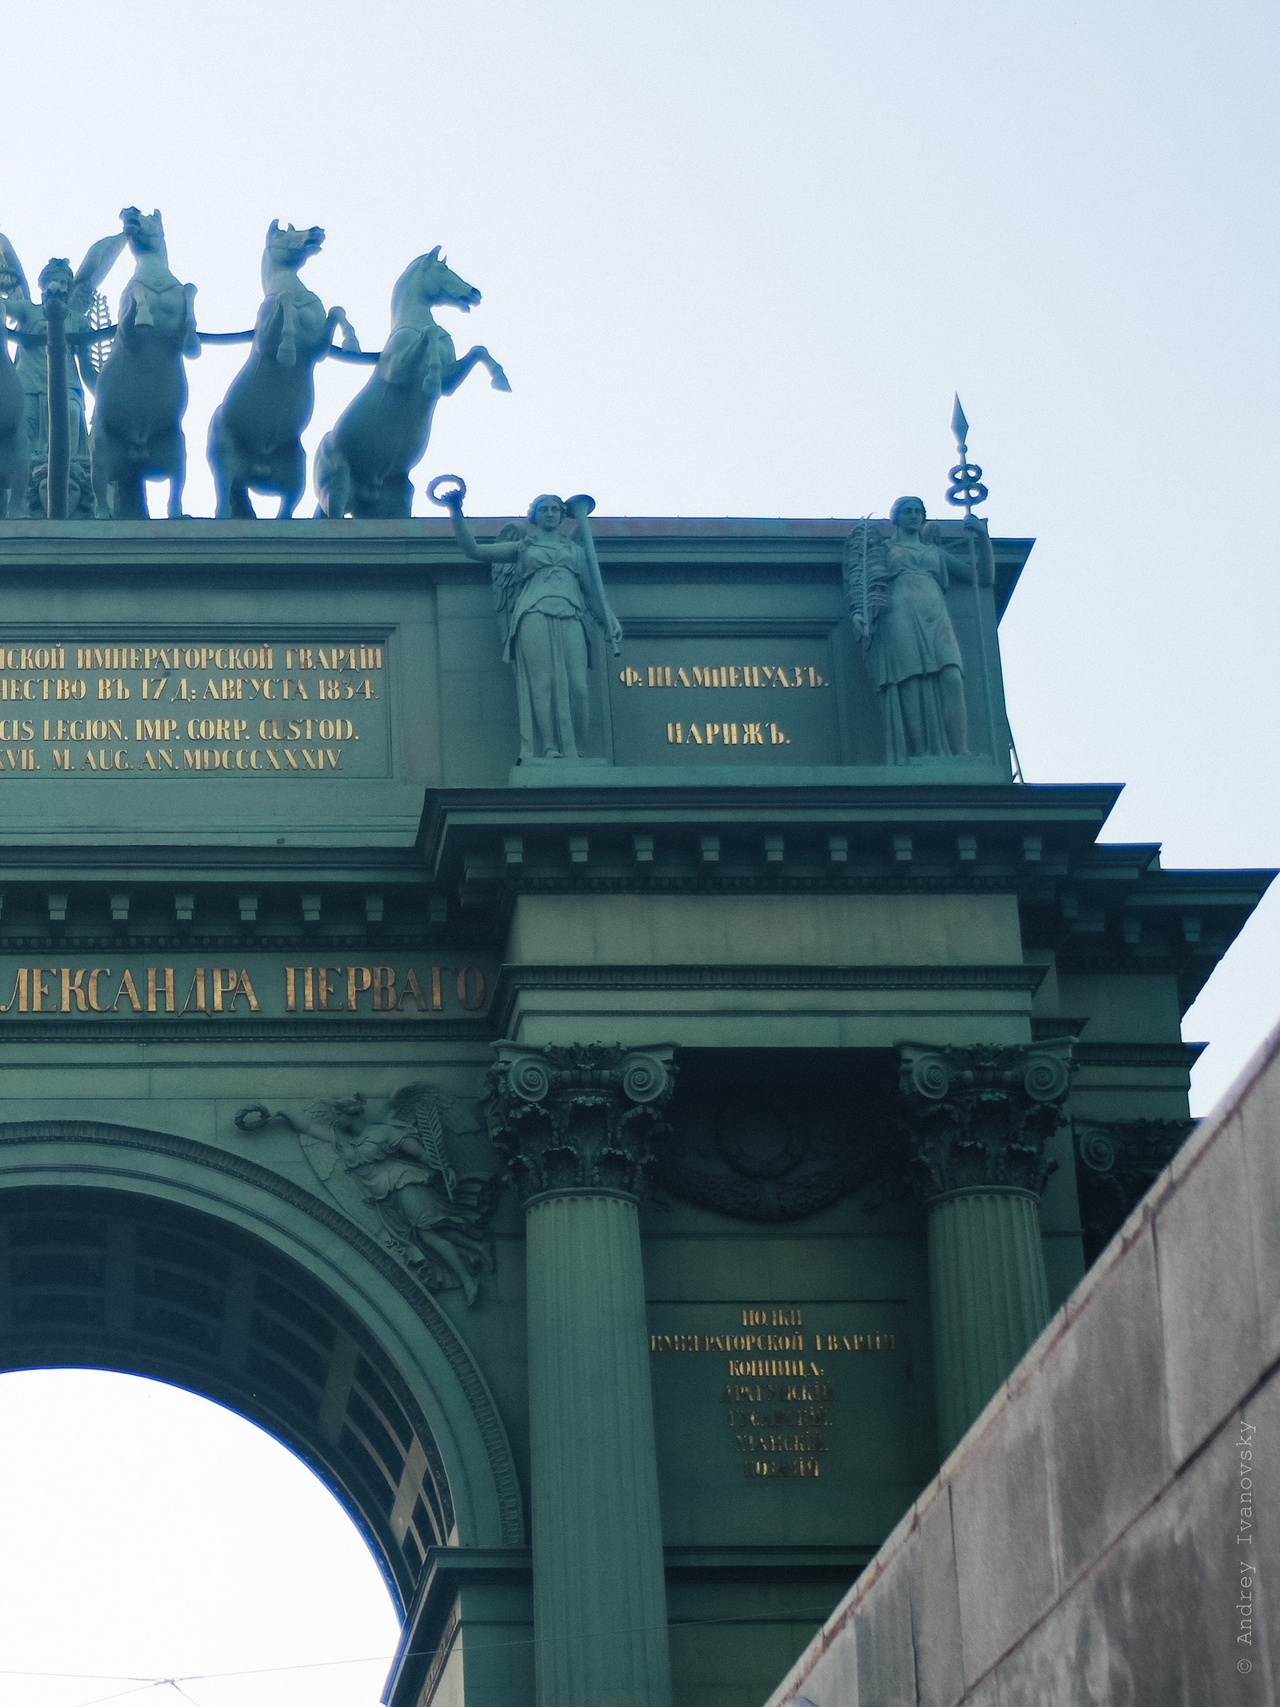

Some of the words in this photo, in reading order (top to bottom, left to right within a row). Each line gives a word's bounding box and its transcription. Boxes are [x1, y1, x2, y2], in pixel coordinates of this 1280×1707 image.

[77, 643, 274, 670] ИМПЕРАТОРСКОЙ
[285, 644, 383, 672] ГВАРДІИ
[648, 666, 829, 688] ШАМПЕНУАЗЪ.
[98, 678, 131, 700] ВЪ
[141, 678, 168, 700] 17
[202, 678, 309, 700] АВГУСТА
[43, 719, 129, 741] LEGION.
[135, 719, 181, 741] IMP.
[187, 719, 250, 741] CORP.
[259, 719, 360, 741] CUSTOD.
[667, 722, 791, 745] ПАРИЖЪ.
[52, 749, 76, 770] M.
[80, 749, 134, 770] AUG.
[142, 749, 180, 770] AN.
[285, 967, 486, 1012] ПЕРВАГО
